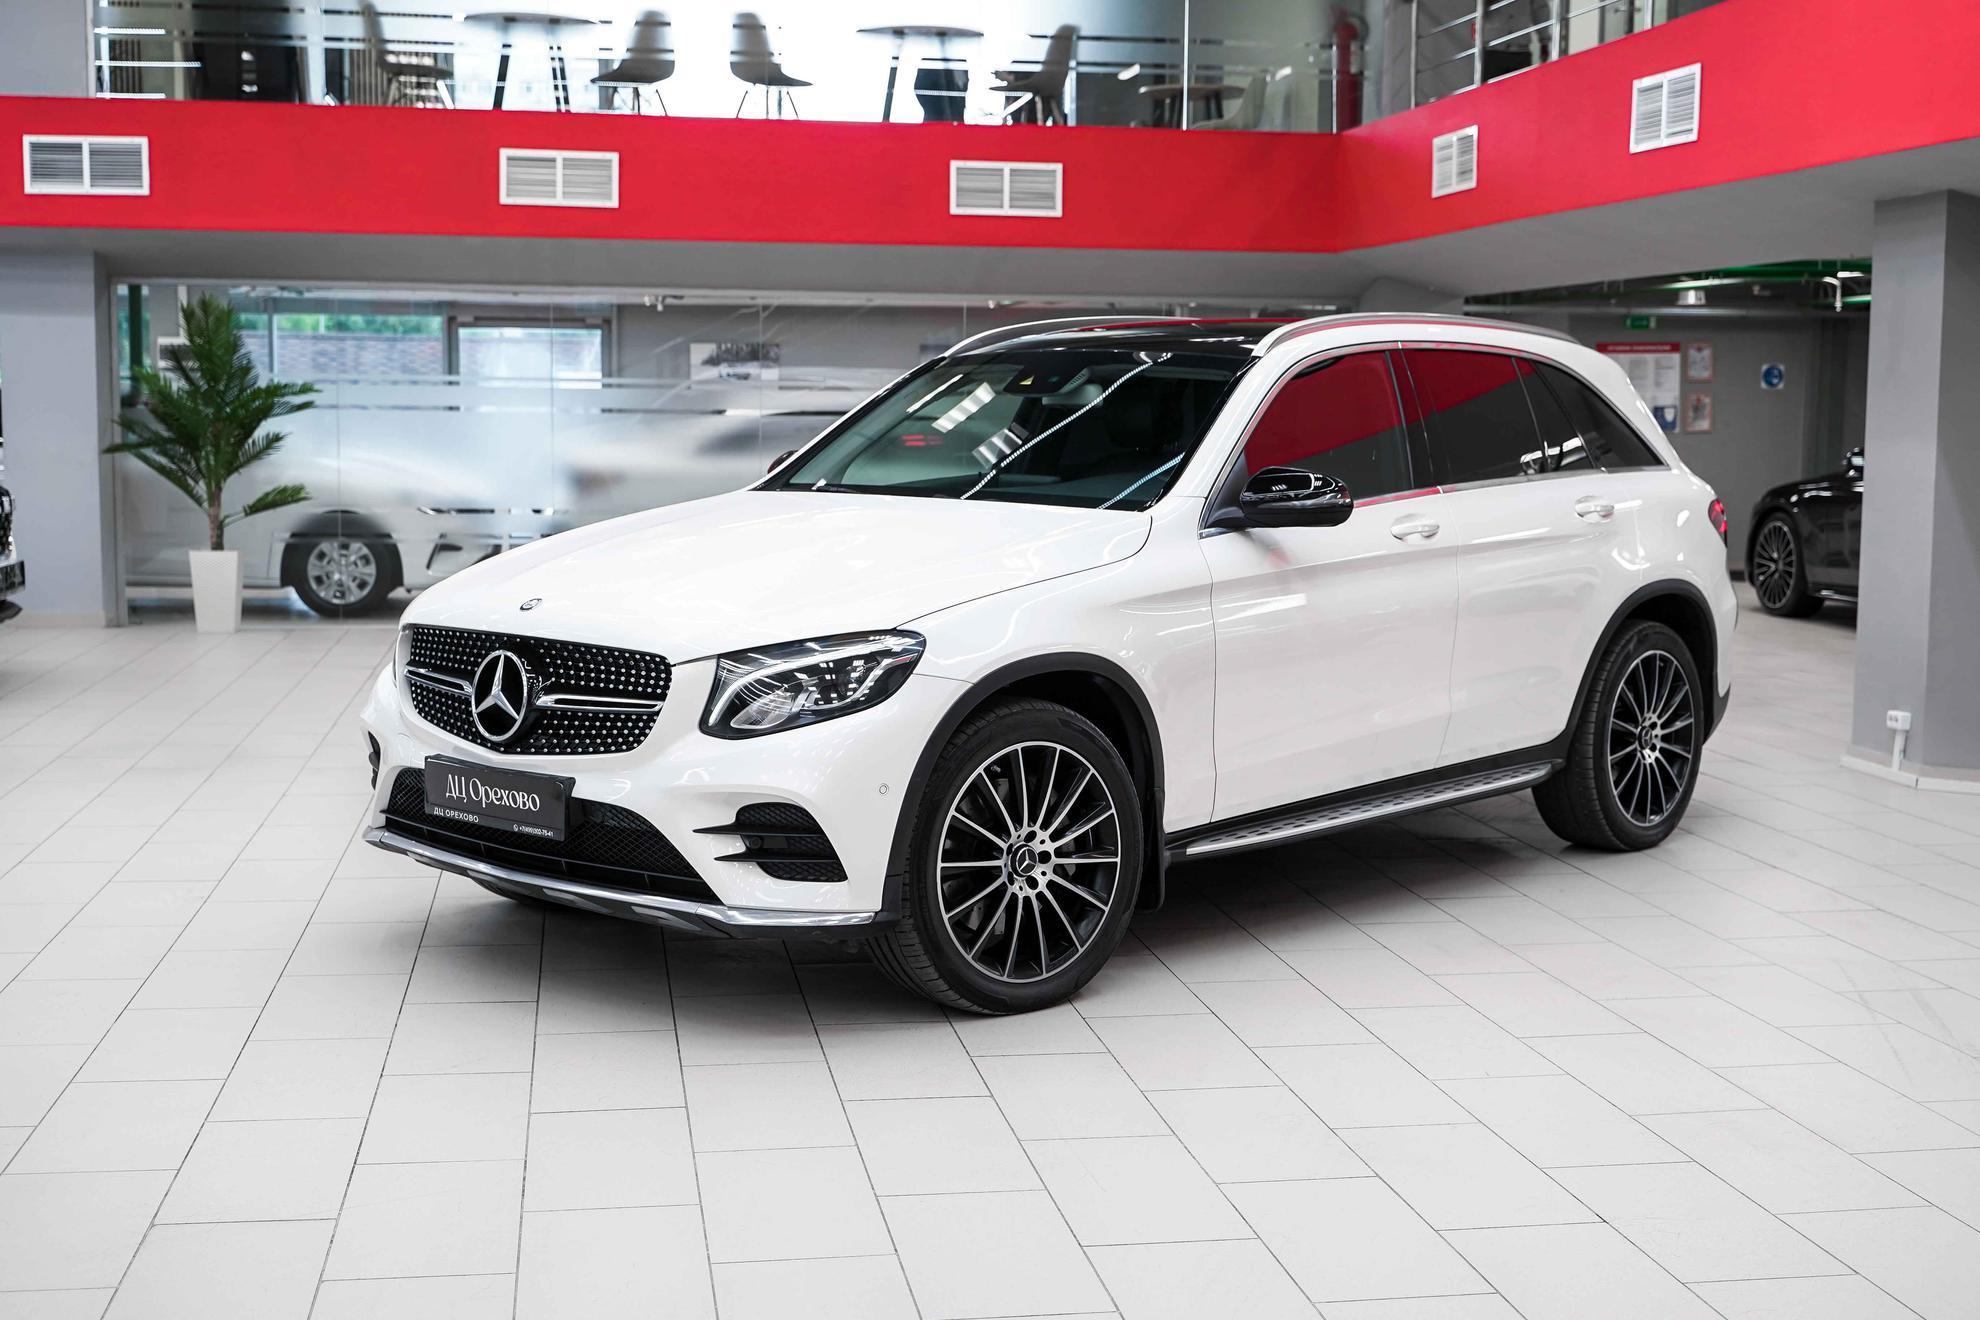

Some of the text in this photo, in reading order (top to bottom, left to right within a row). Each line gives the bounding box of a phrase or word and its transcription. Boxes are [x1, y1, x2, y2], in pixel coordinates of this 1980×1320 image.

[446, 774, 540, 811] ДЦ Орехово
[433, 807, 479, 823] ДЦ ОРЕХОВО
